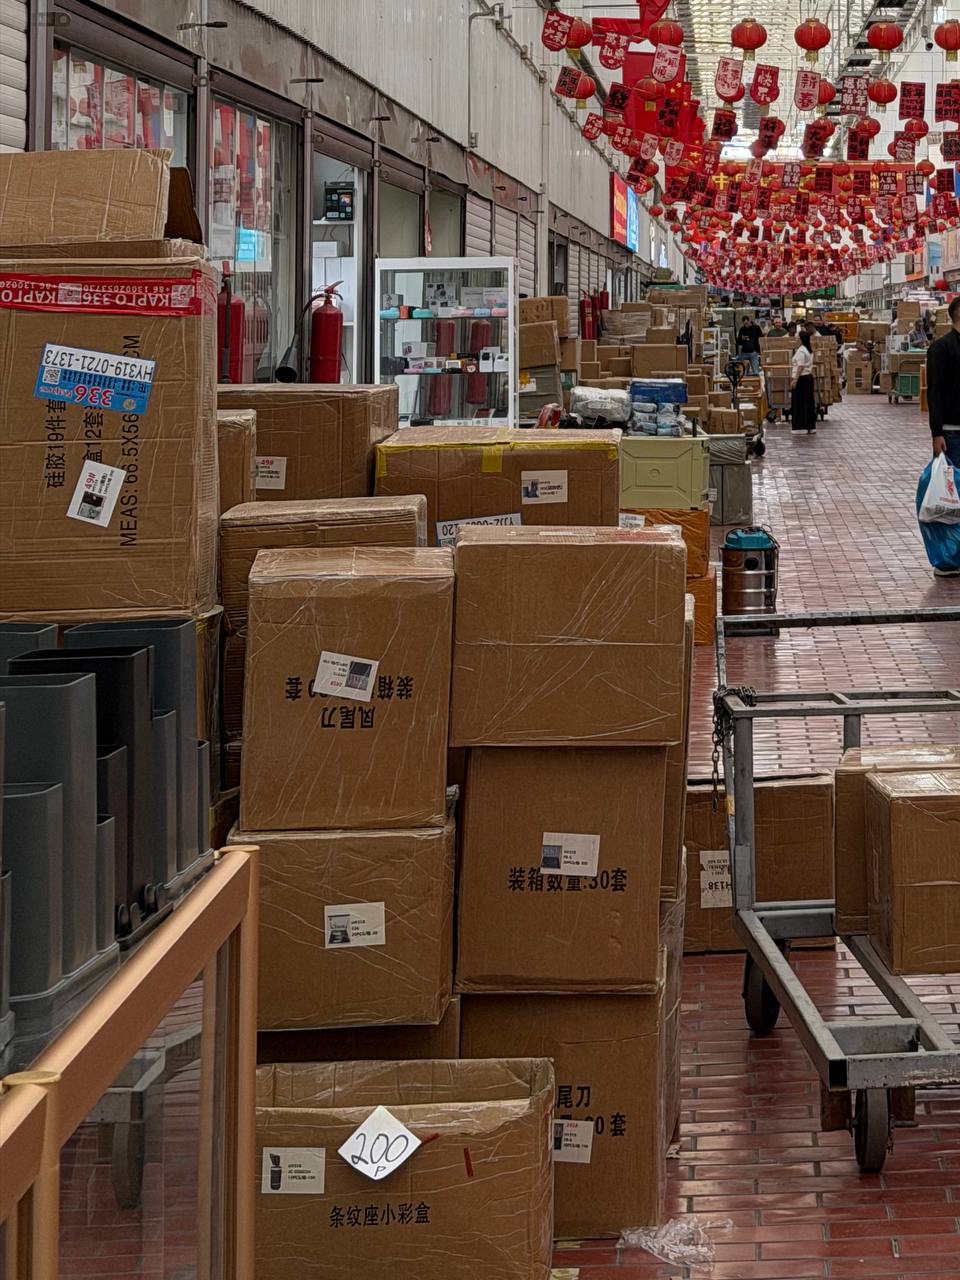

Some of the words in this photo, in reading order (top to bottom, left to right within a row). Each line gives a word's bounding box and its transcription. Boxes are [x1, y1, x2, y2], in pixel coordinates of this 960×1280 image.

[1, 289, 56, 305] КАРГО
[83, 292, 111, 306] 336
[114, 293, 172, 307] КАРГО
[44, 349, 155, 383] HY319-0721-1373
[74, 385, 115, 406] 336
[120, 486, 138, 546] MEAS:
[321, 706, 374, 729] 凤尾刀
[351, 1132, 409, 1166] 200
[328, 1201, 431, 1229] 条纹座小彩盒
